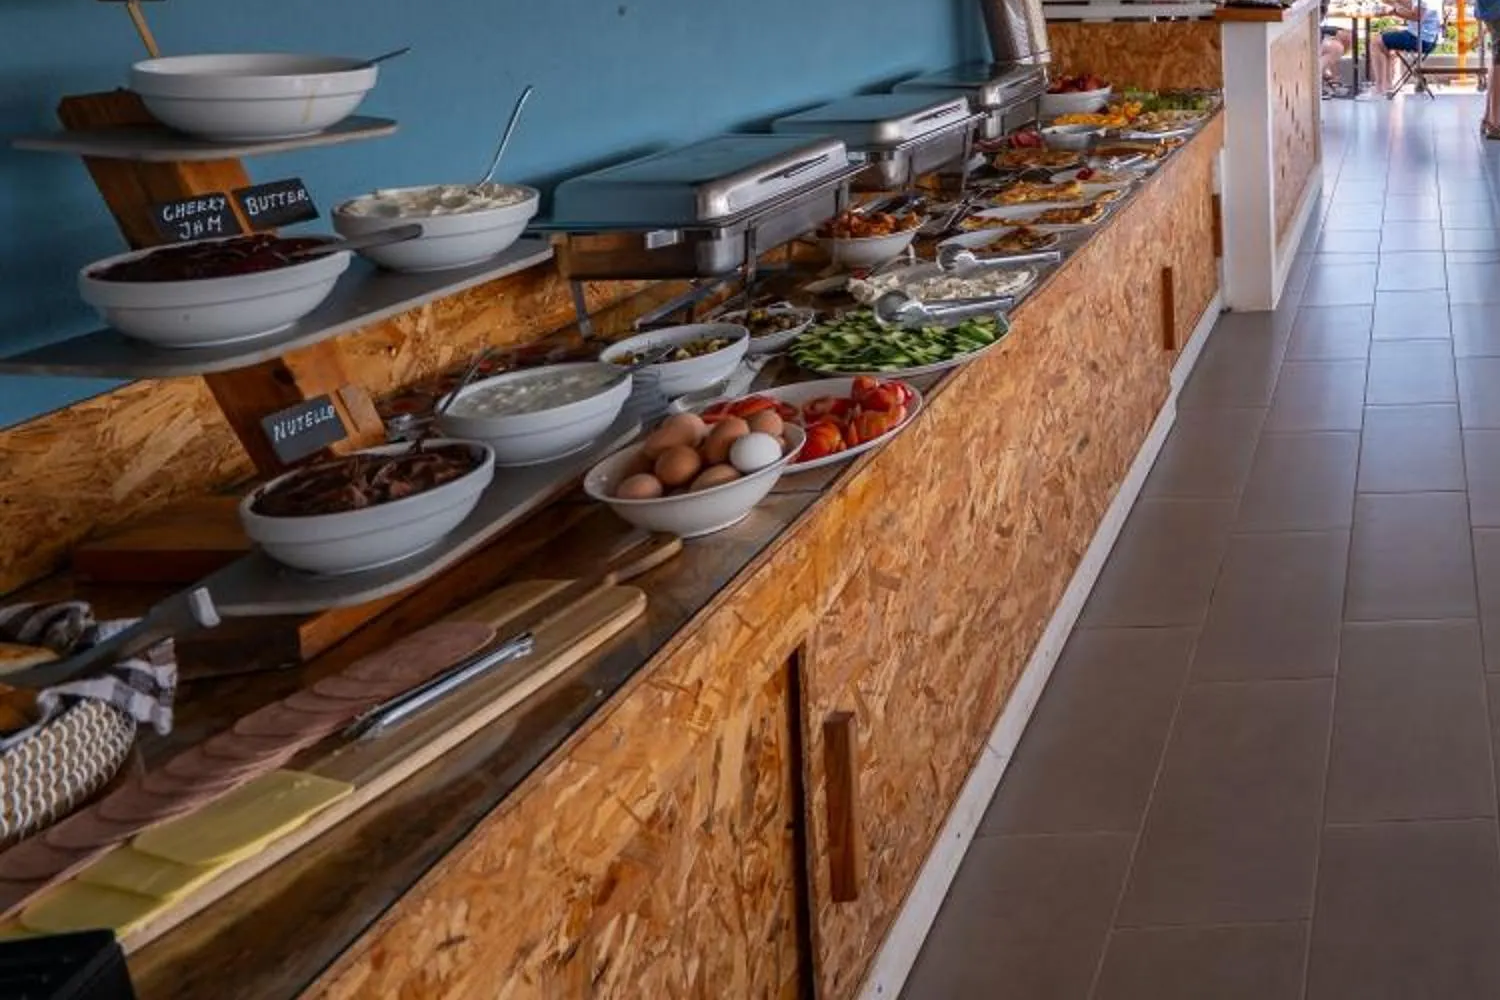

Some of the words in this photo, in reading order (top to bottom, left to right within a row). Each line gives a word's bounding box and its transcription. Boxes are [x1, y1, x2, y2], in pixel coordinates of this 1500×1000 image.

[162, 197, 226, 222] CHERRY
[245, 188, 309, 216] BUTTER
[179, 215, 222, 240] JAM
